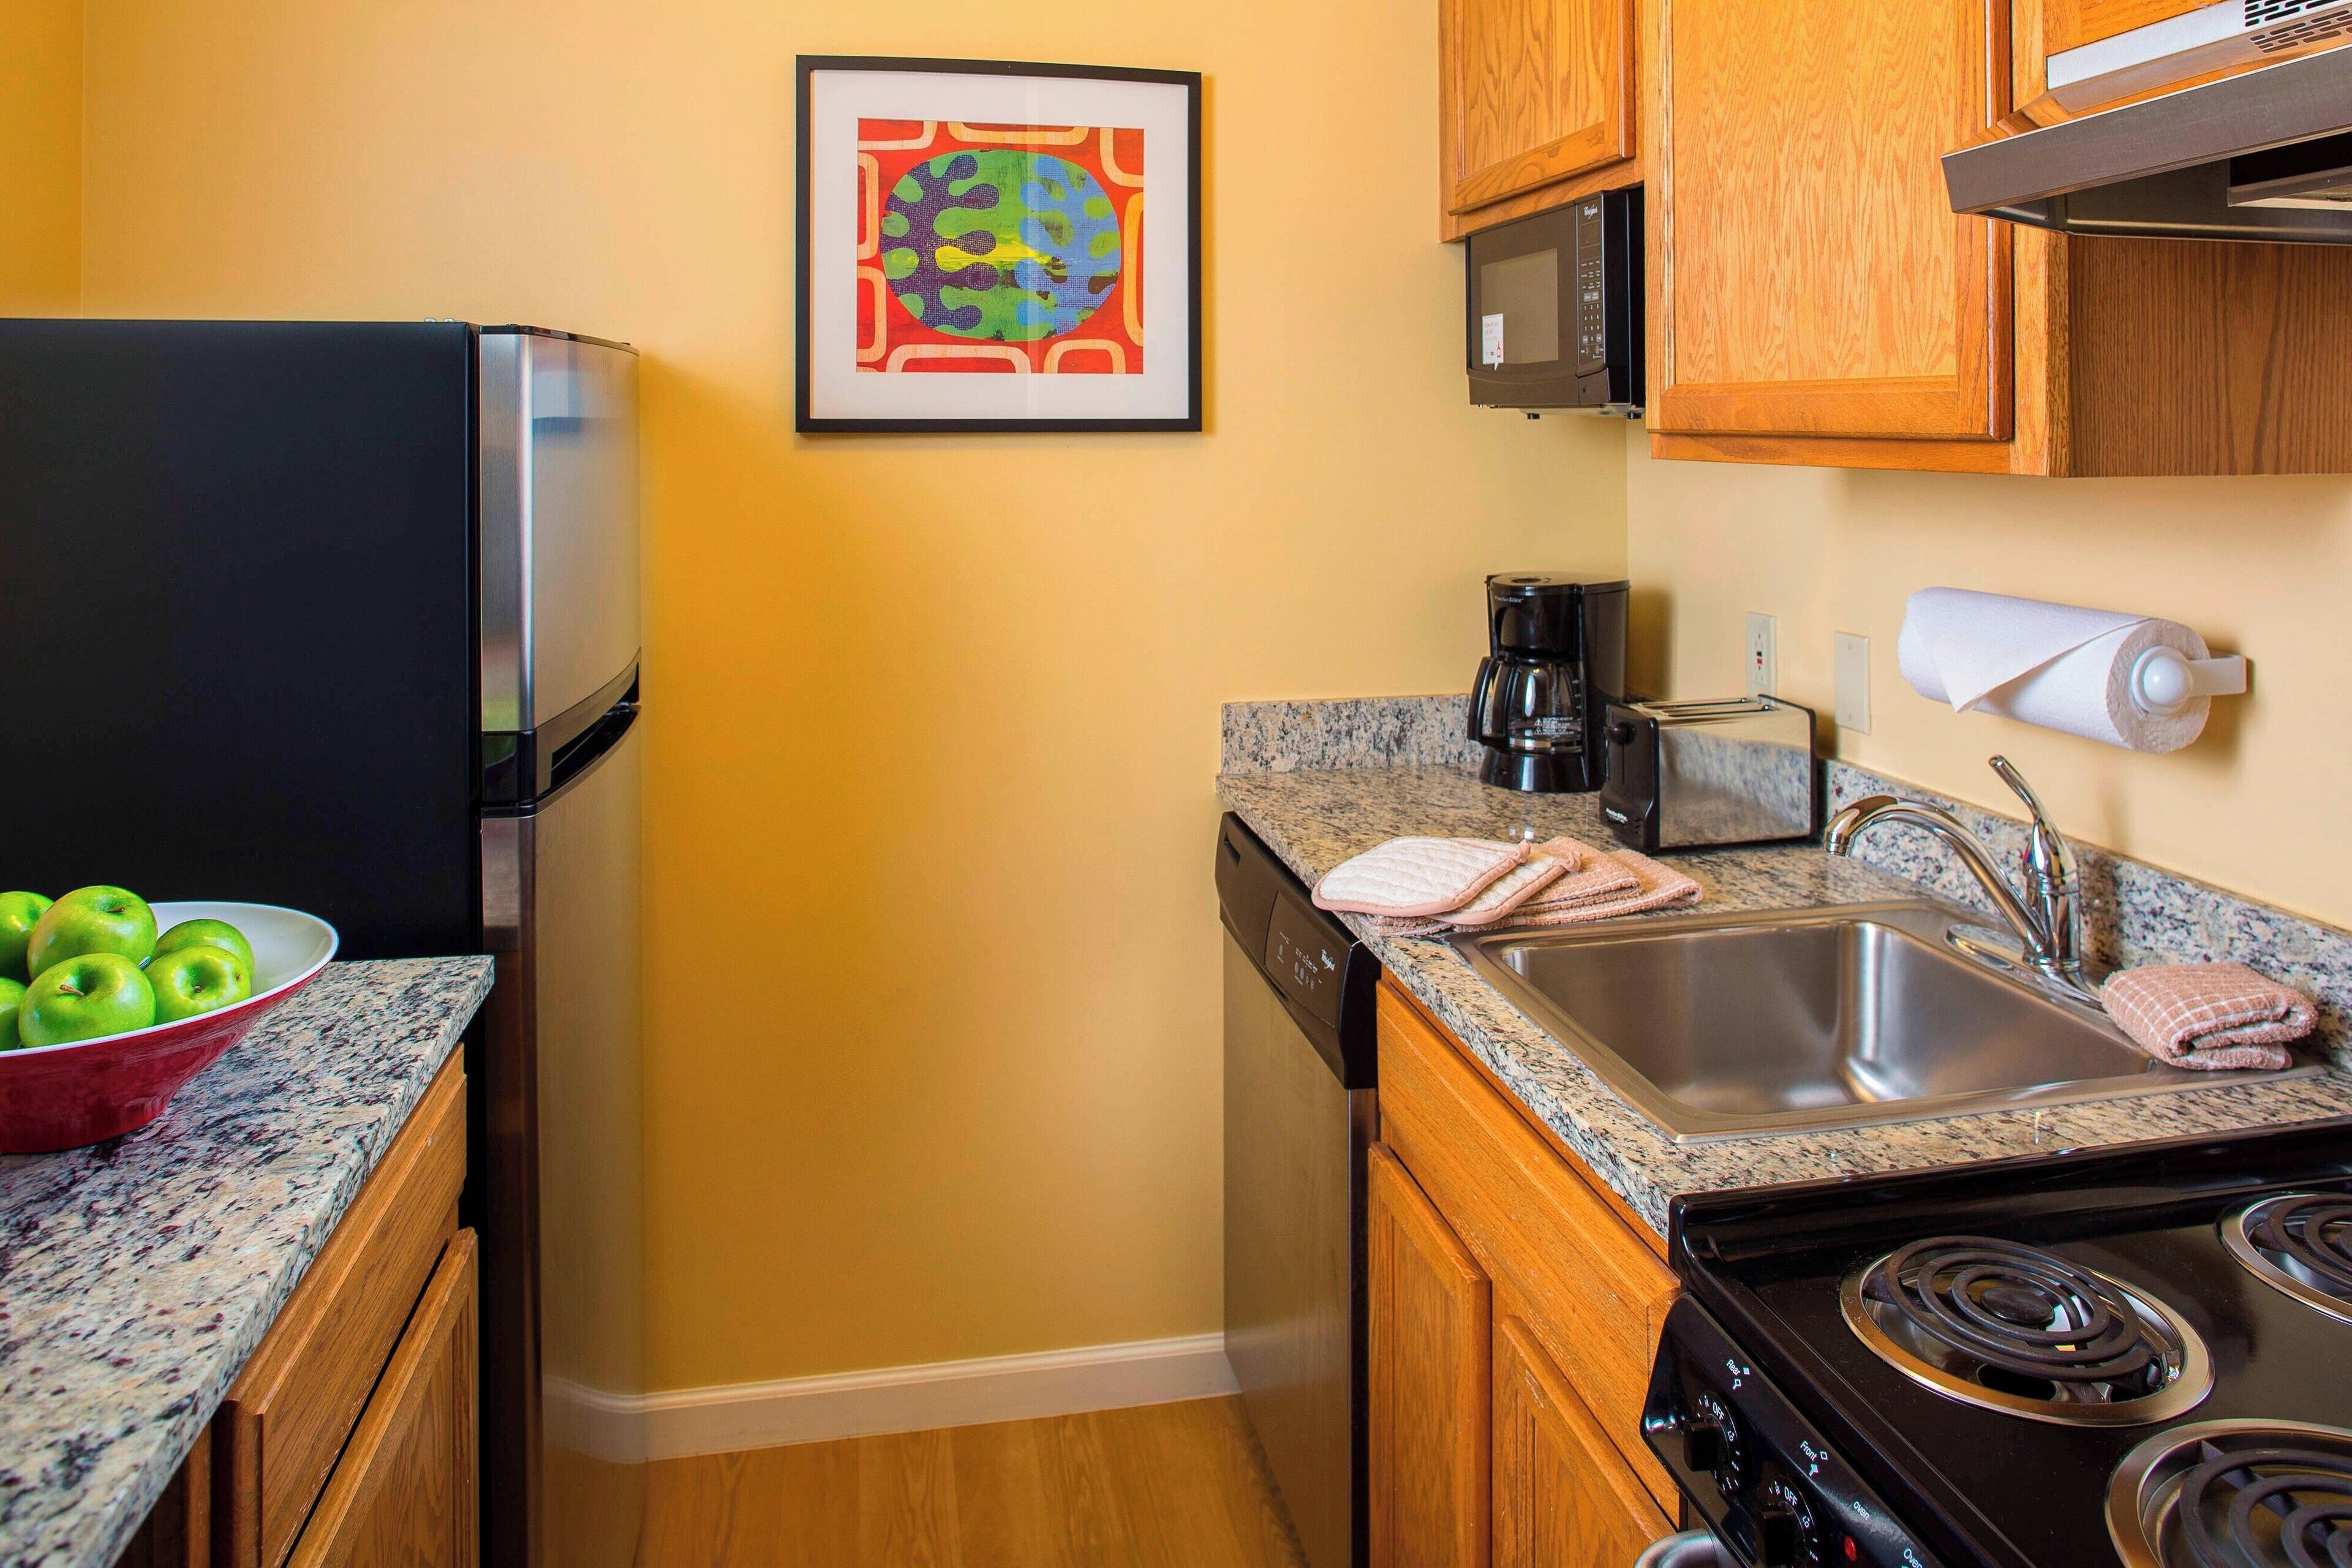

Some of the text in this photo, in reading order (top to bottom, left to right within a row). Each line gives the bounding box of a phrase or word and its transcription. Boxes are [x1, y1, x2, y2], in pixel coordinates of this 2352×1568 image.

[1727, 1359, 1740, 1376] Rear
[1713, 1402, 1724, 1420] OFF
[1800, 1441, 1817, 1461] Front
[1785, 1487, 1797, 1506] OFF
[1853, 1501, 1869, 1520] oven
